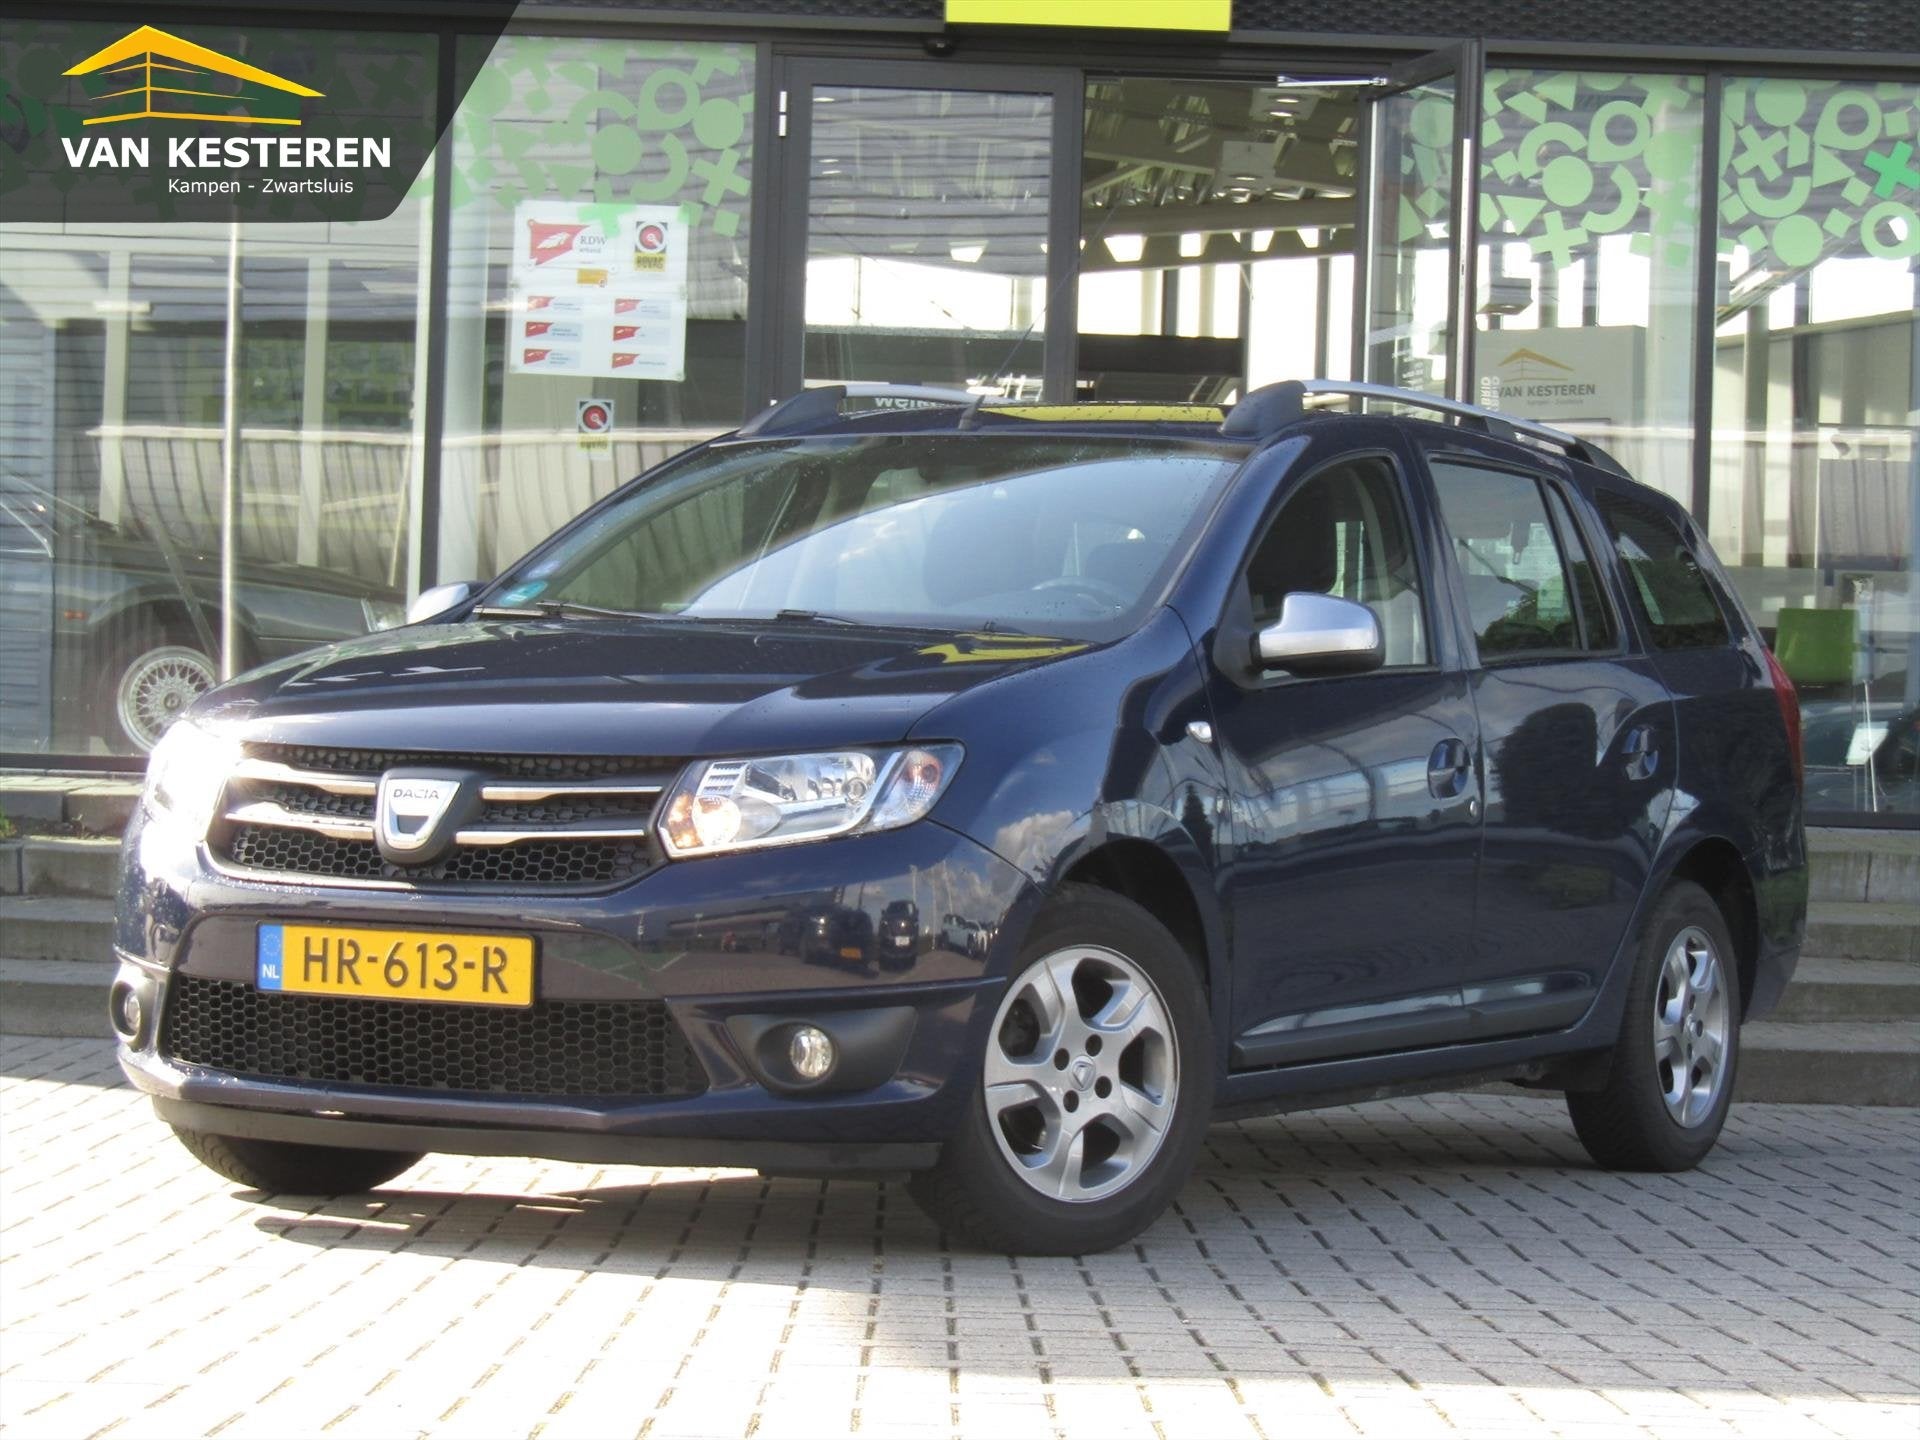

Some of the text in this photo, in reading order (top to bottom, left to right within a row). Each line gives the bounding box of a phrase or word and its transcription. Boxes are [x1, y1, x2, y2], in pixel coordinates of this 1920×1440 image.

[1498, 384, 1596, 398] VAN KESTEREN
[393, 788, 440, 800] DACIA
[262, 963, 280, 979] NL
[303, 936, 509, 994] HR-613-R
